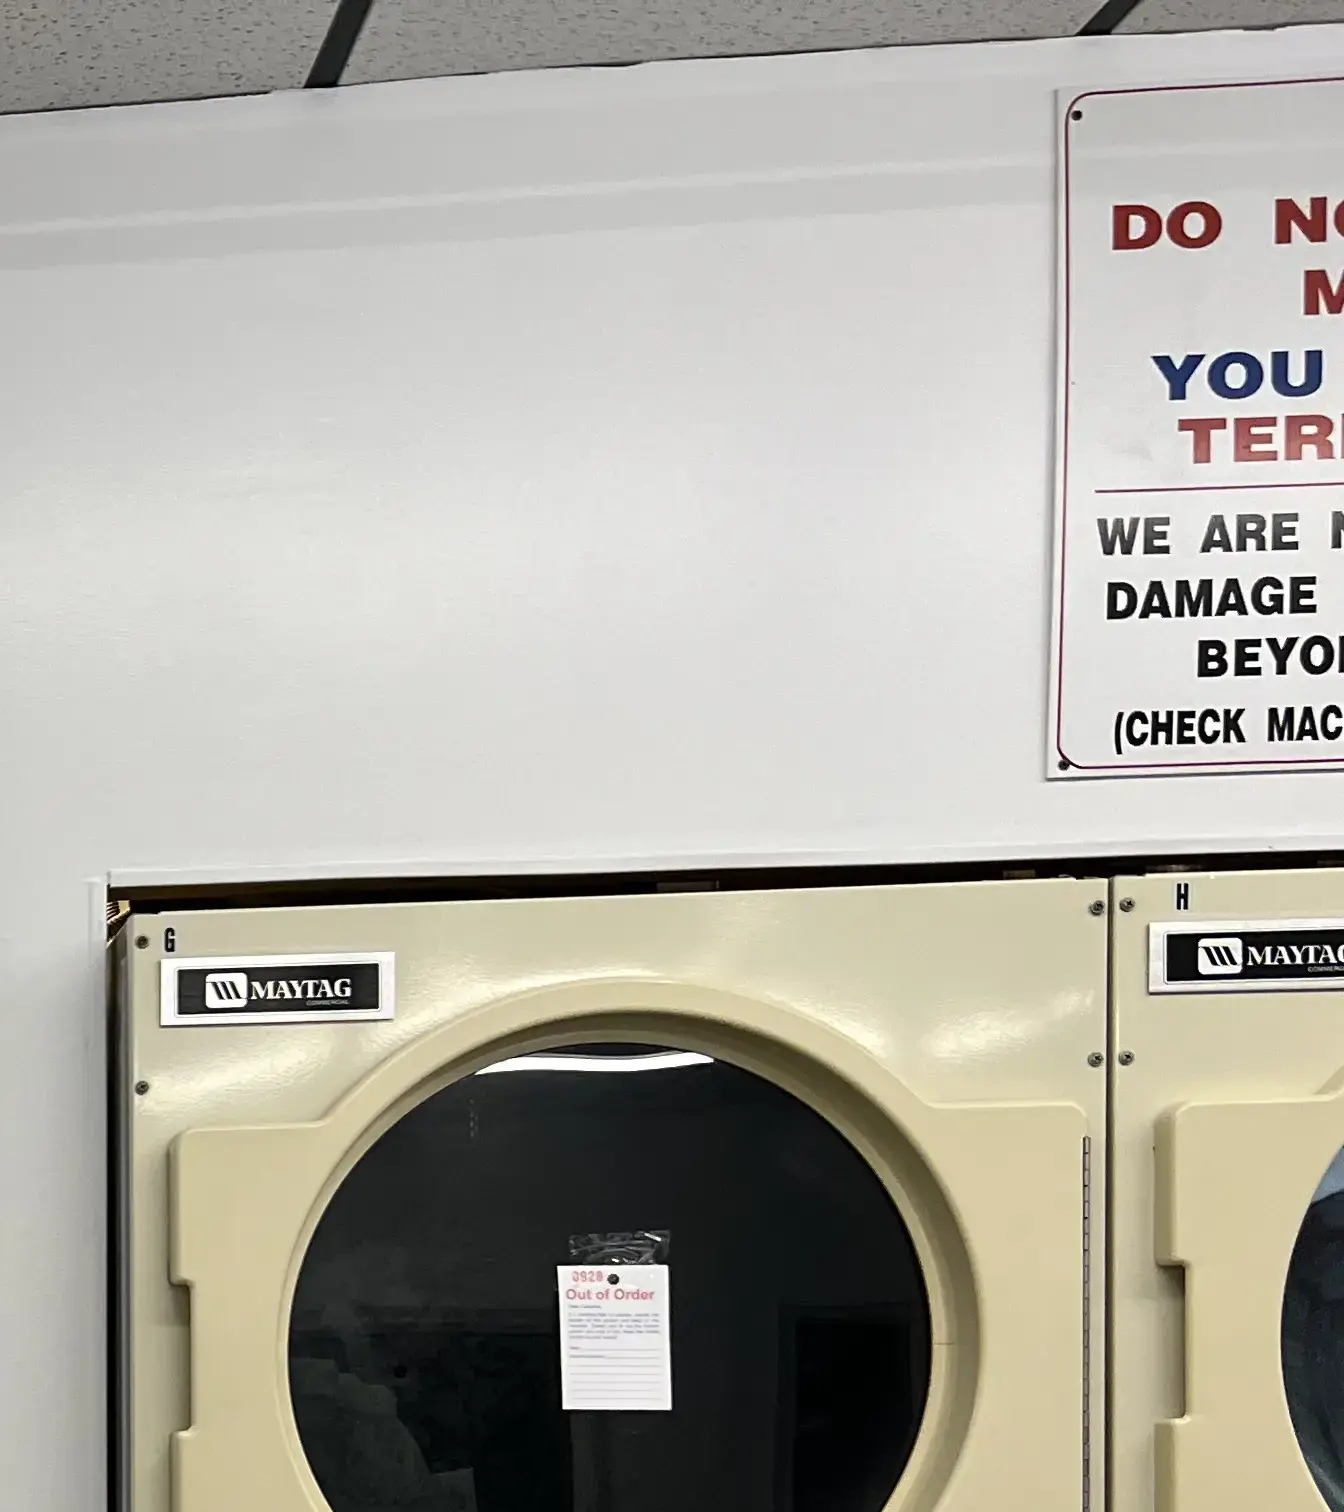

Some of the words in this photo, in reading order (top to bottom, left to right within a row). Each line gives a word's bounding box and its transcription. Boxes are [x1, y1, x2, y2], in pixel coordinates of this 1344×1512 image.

[1112, 200, 1222, 250] DO
[1275, 196, 1344, 244] N
[1150, 350, 1323, 401] YOU
[1178, 413, 1344, 464] TER
[1096, 516, 1170, 556] WE
[1199, 512, 1299, 553] ARE
[1106, 576, 1317, 620] DAMAGE
[1197, 635, 1344, 678] BEYO
[1114, 708, 1246, 755] (CHECK
[1176, 883, 1189, 910] H
[164, 927, 176, 952] G
[250, 978, 352, 1001] MAYTAG
[566, 1288, 592, 1300] Out
[596, 1288, 610, 1300] of
[614, 1288, 655, 1300] Order
